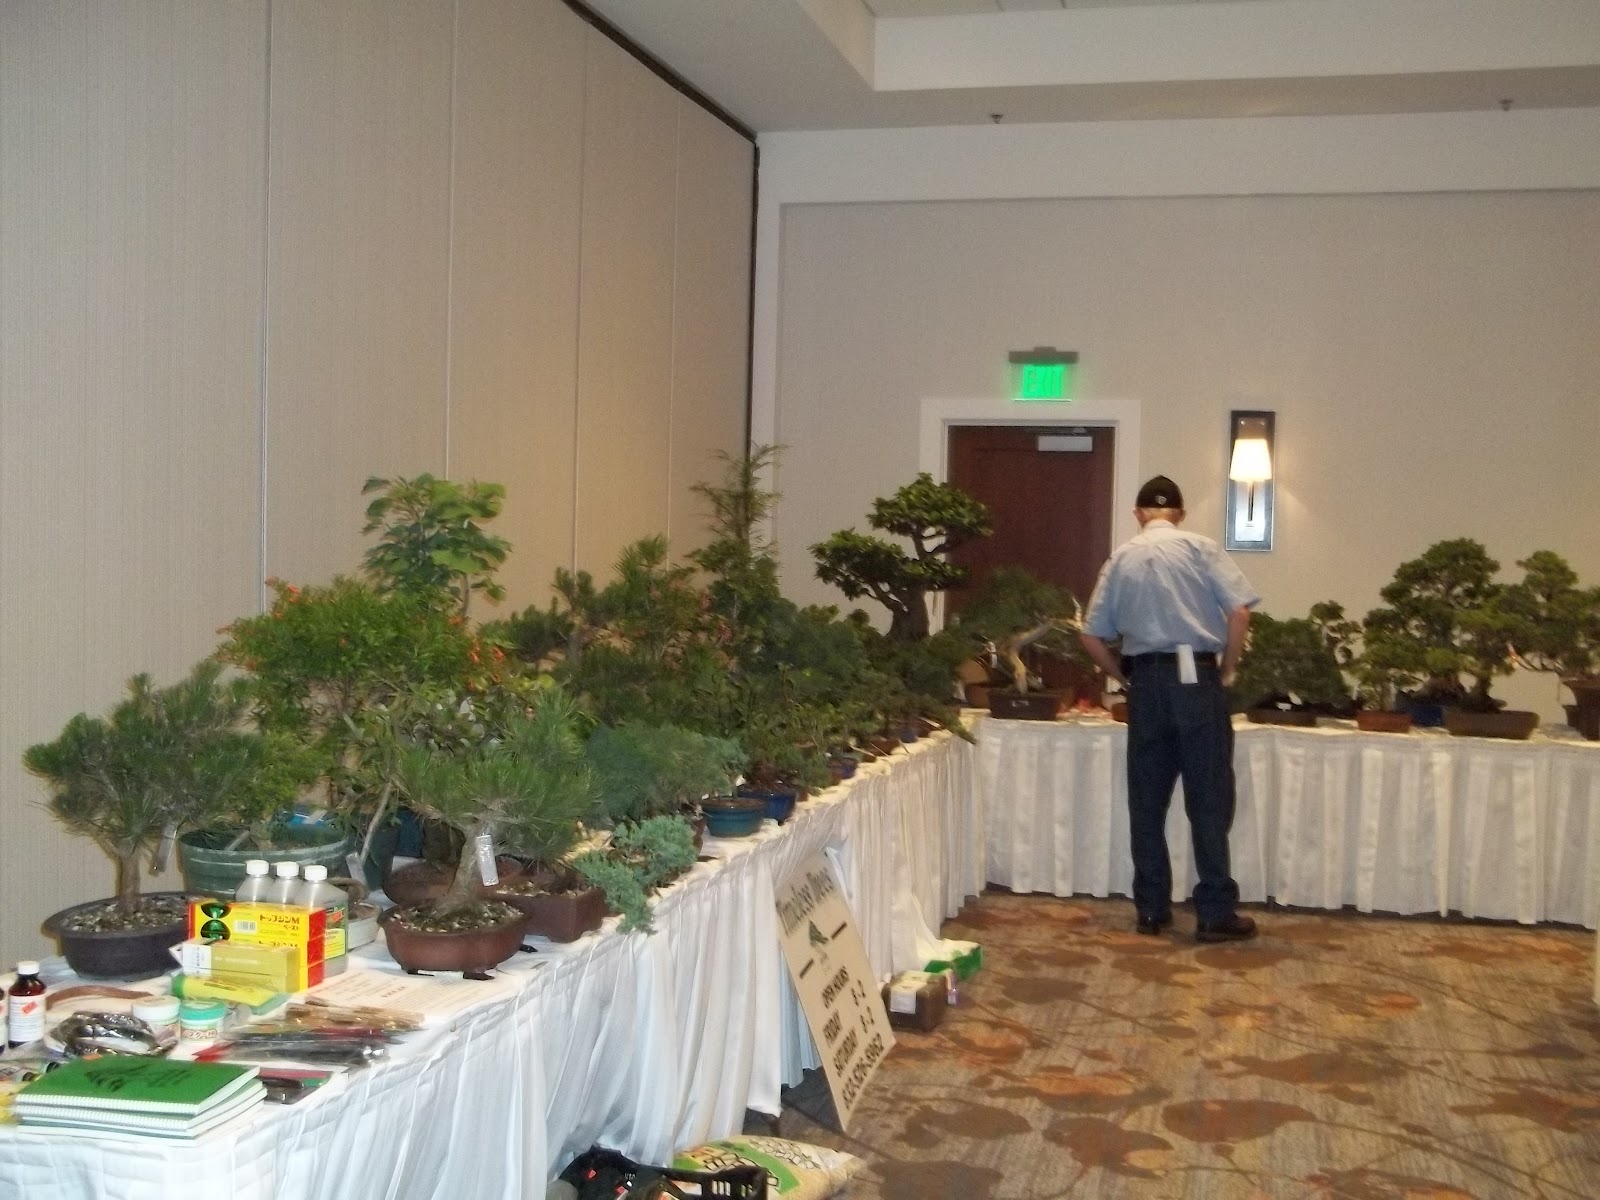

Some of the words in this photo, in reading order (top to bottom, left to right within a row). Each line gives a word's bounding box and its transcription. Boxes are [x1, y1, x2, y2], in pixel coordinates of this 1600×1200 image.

[1023, 364, 1065, 398] EXIT
[259, 914, 300, 924] トップジンM
[823, 1010, 843, 1048] FRIDAY
[832, 1027, 859, 1078] SATURDAY
